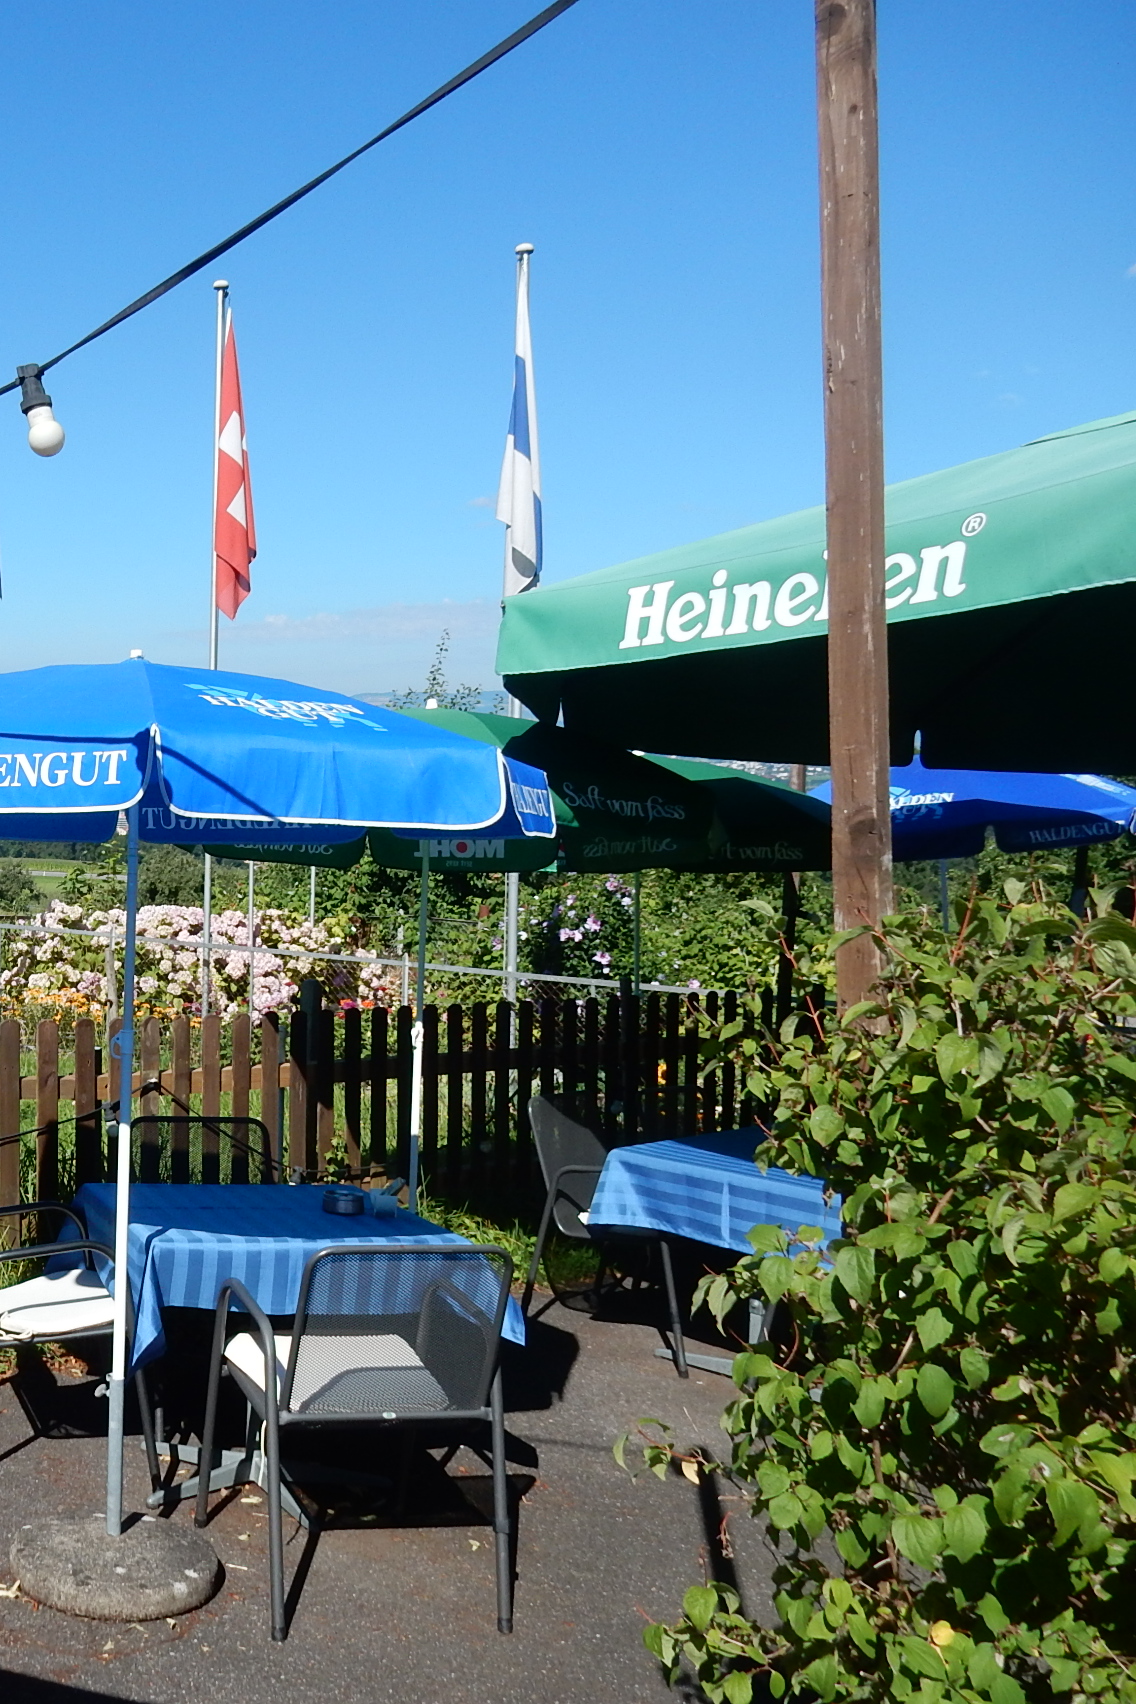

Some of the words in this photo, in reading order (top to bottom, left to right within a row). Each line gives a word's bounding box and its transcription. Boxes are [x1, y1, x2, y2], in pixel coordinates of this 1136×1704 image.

[198, 694, 364, 715] HALDEN
[257, 706, 345, 724] GUT
[563, 782, 605, 810] Saft
[606, 799, 645, 818] vom
